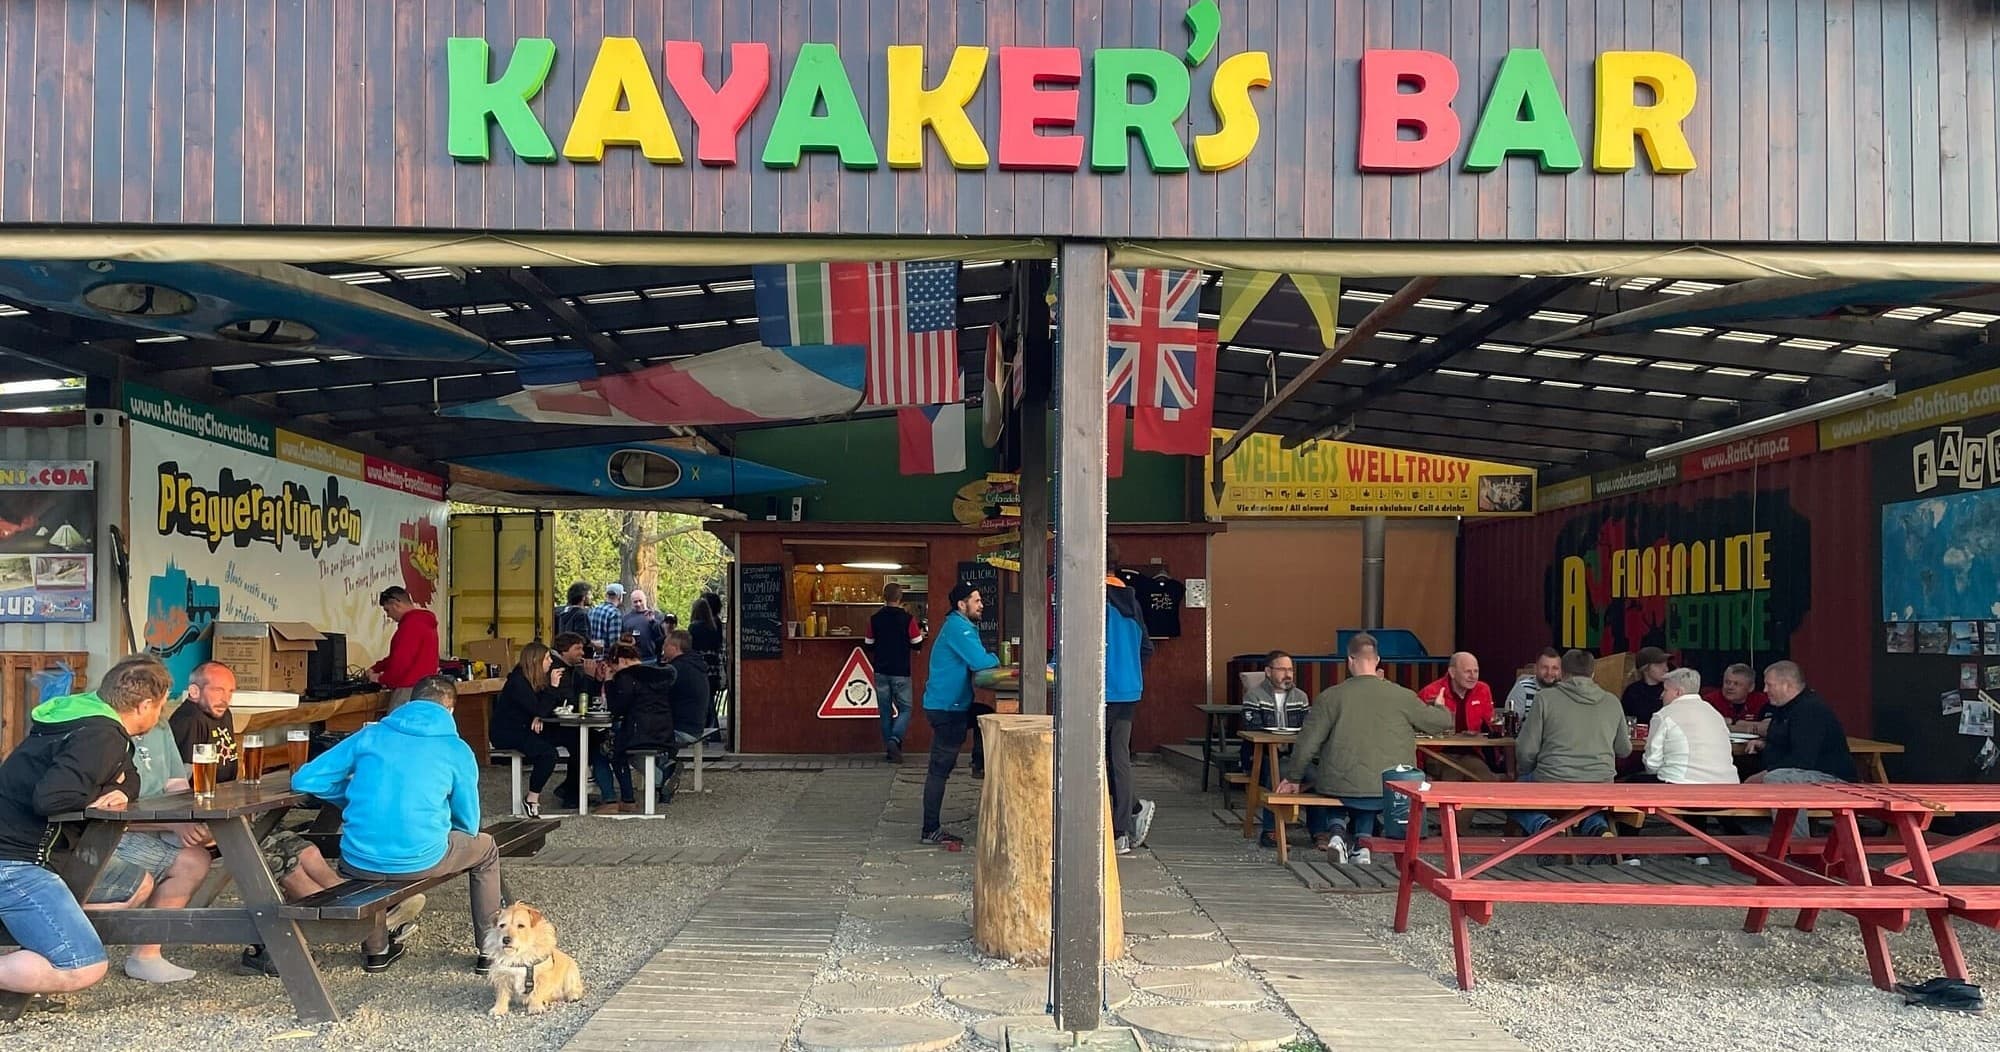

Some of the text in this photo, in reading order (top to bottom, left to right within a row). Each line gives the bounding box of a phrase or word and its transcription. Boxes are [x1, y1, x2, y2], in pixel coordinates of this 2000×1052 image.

[448, 0, 1697, 174] KAYAKER'S BAR
[1232, 435, 1470, 483] WELLNESS WELLTRUSY
[1702, 435, 1790, 470] www.RaftCamp.cz
[1612, 531, 1771, 598] ADRENALINE
